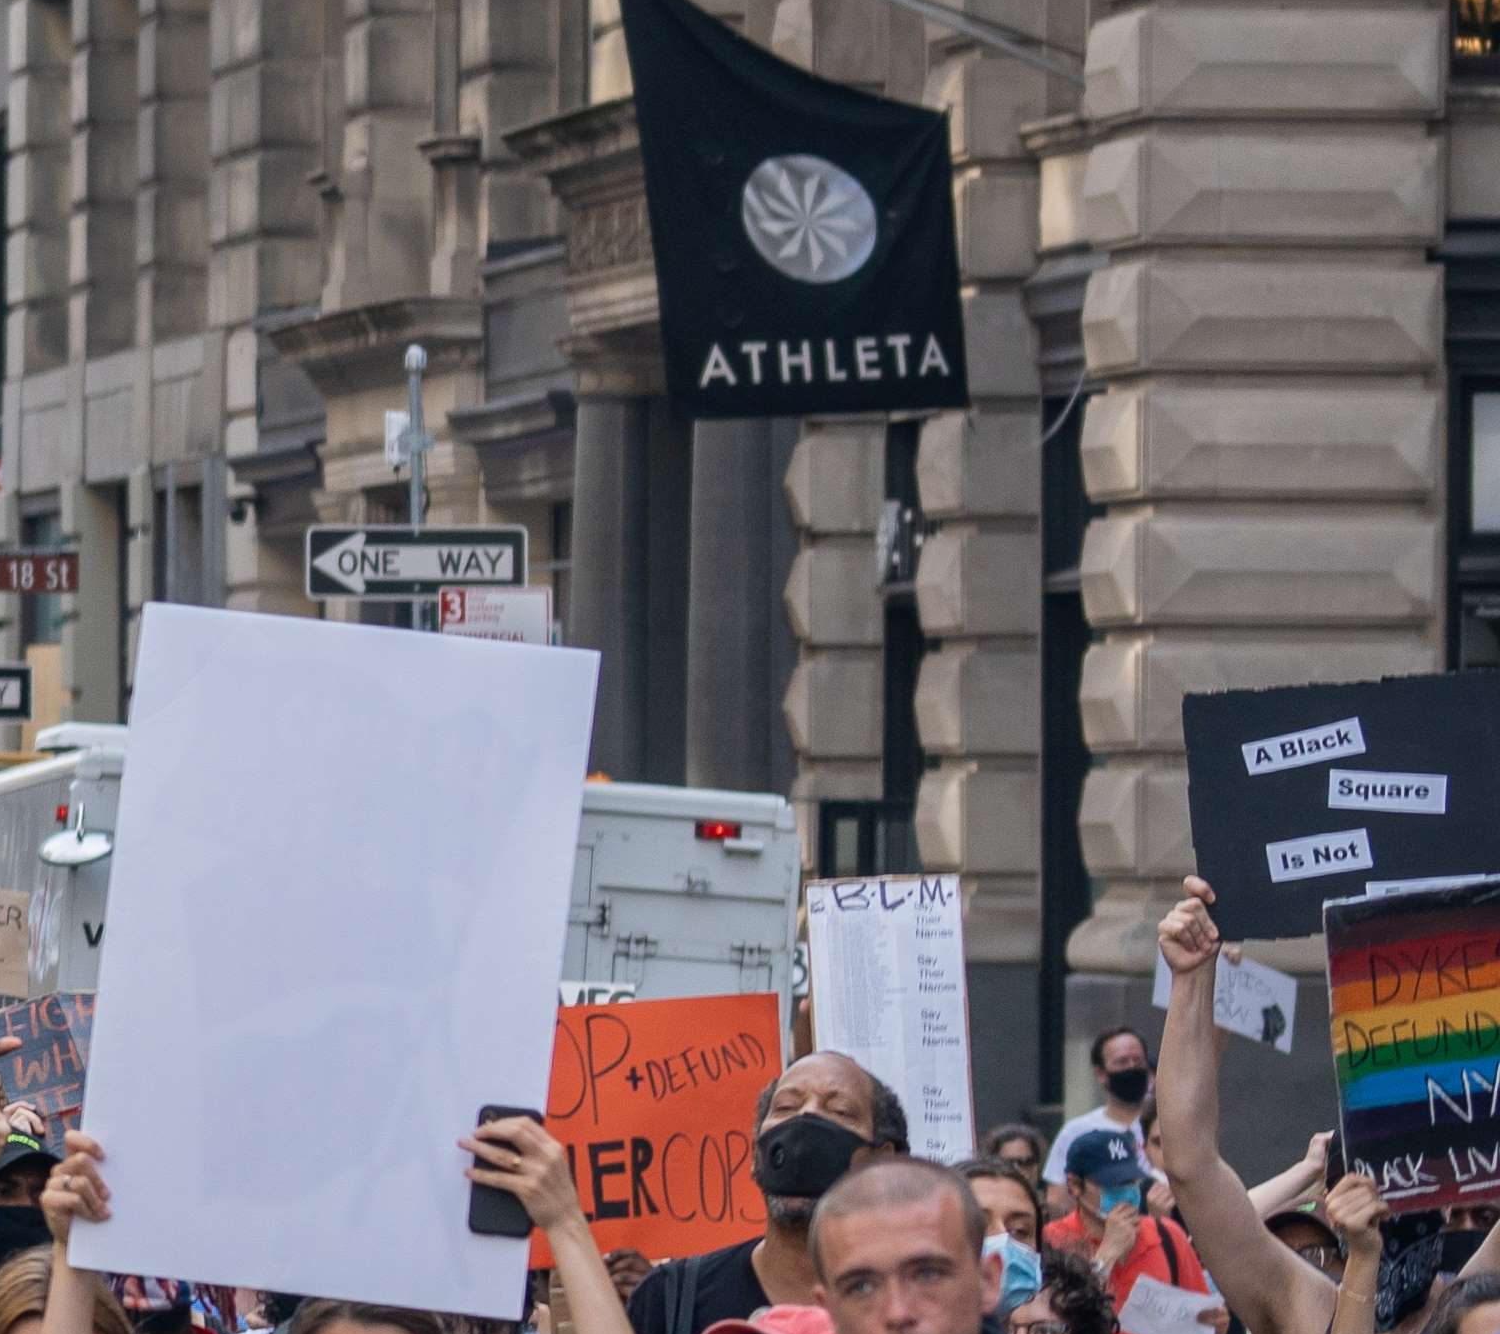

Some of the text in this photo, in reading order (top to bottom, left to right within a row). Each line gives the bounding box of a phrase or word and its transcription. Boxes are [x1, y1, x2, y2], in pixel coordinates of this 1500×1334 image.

[701, 333, 950, 388] ATHLETA
[9, 560, 34, 588] 18
[46, 560, 70, 589] St
[338, 550, 503, 575] ONE WAY
[1255, 728, 1353, 765] A Black
[1338, 778, 1430, 800] Square
[1281, 841, 1360, 870] Is Not
[1344, 1010, 1500, 1068] DEFUND
